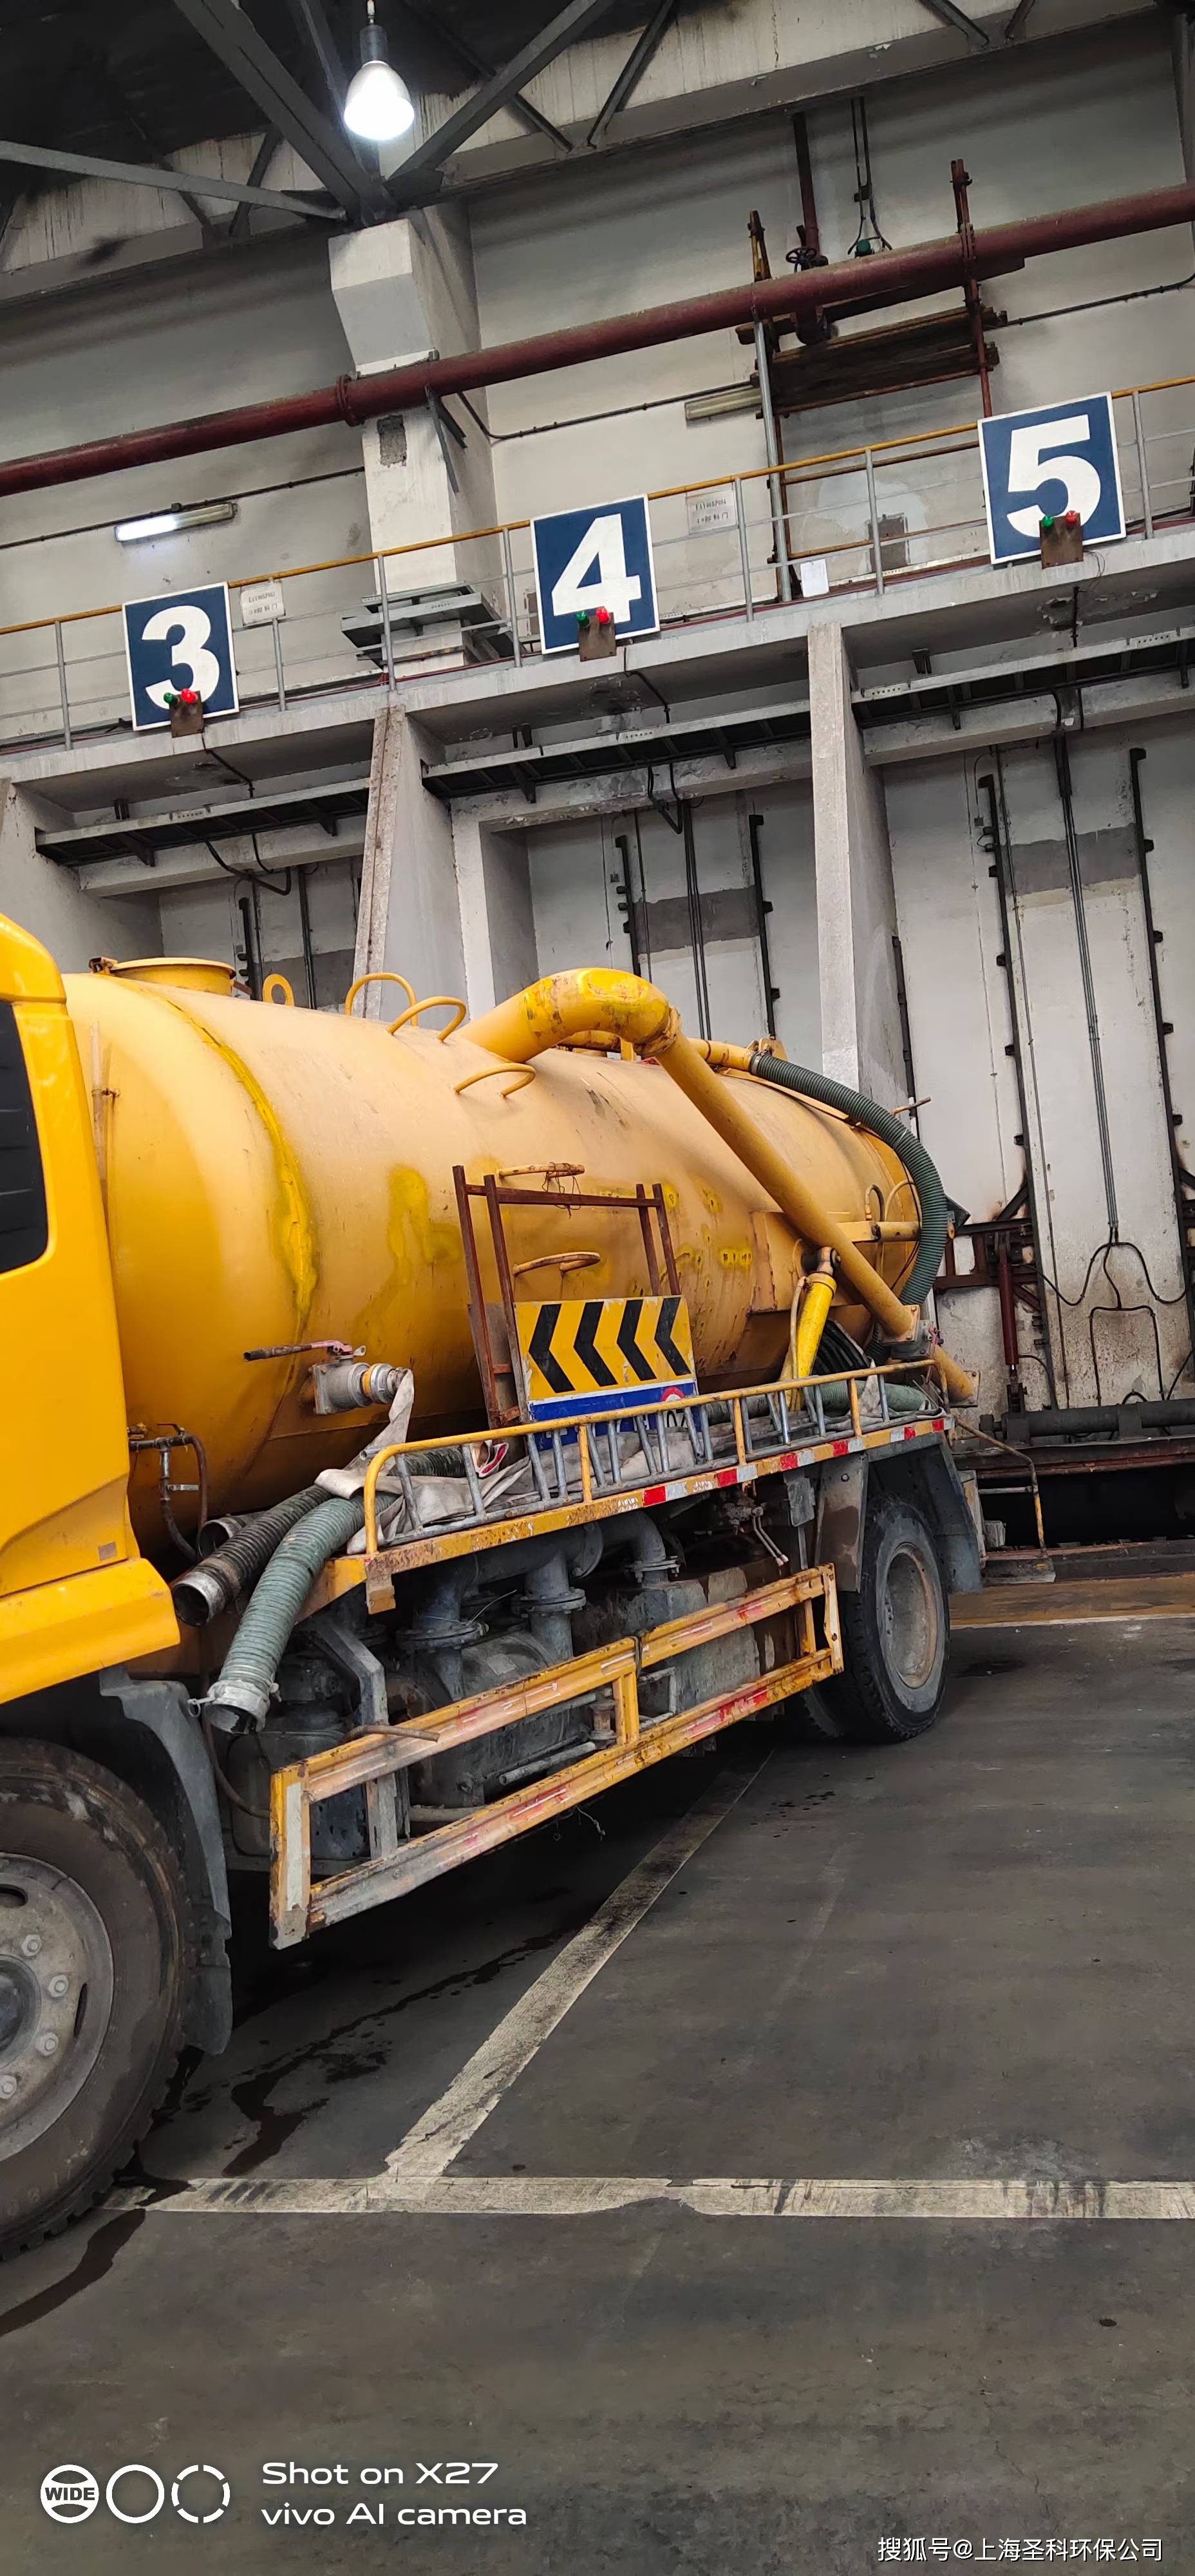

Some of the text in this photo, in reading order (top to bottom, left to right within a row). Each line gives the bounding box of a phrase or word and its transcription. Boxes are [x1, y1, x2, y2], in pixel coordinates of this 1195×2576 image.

[1006, 414, 1101, 538] 5
[551, 513, 642, 624] 4
[142, 605, 220, 710] 3
